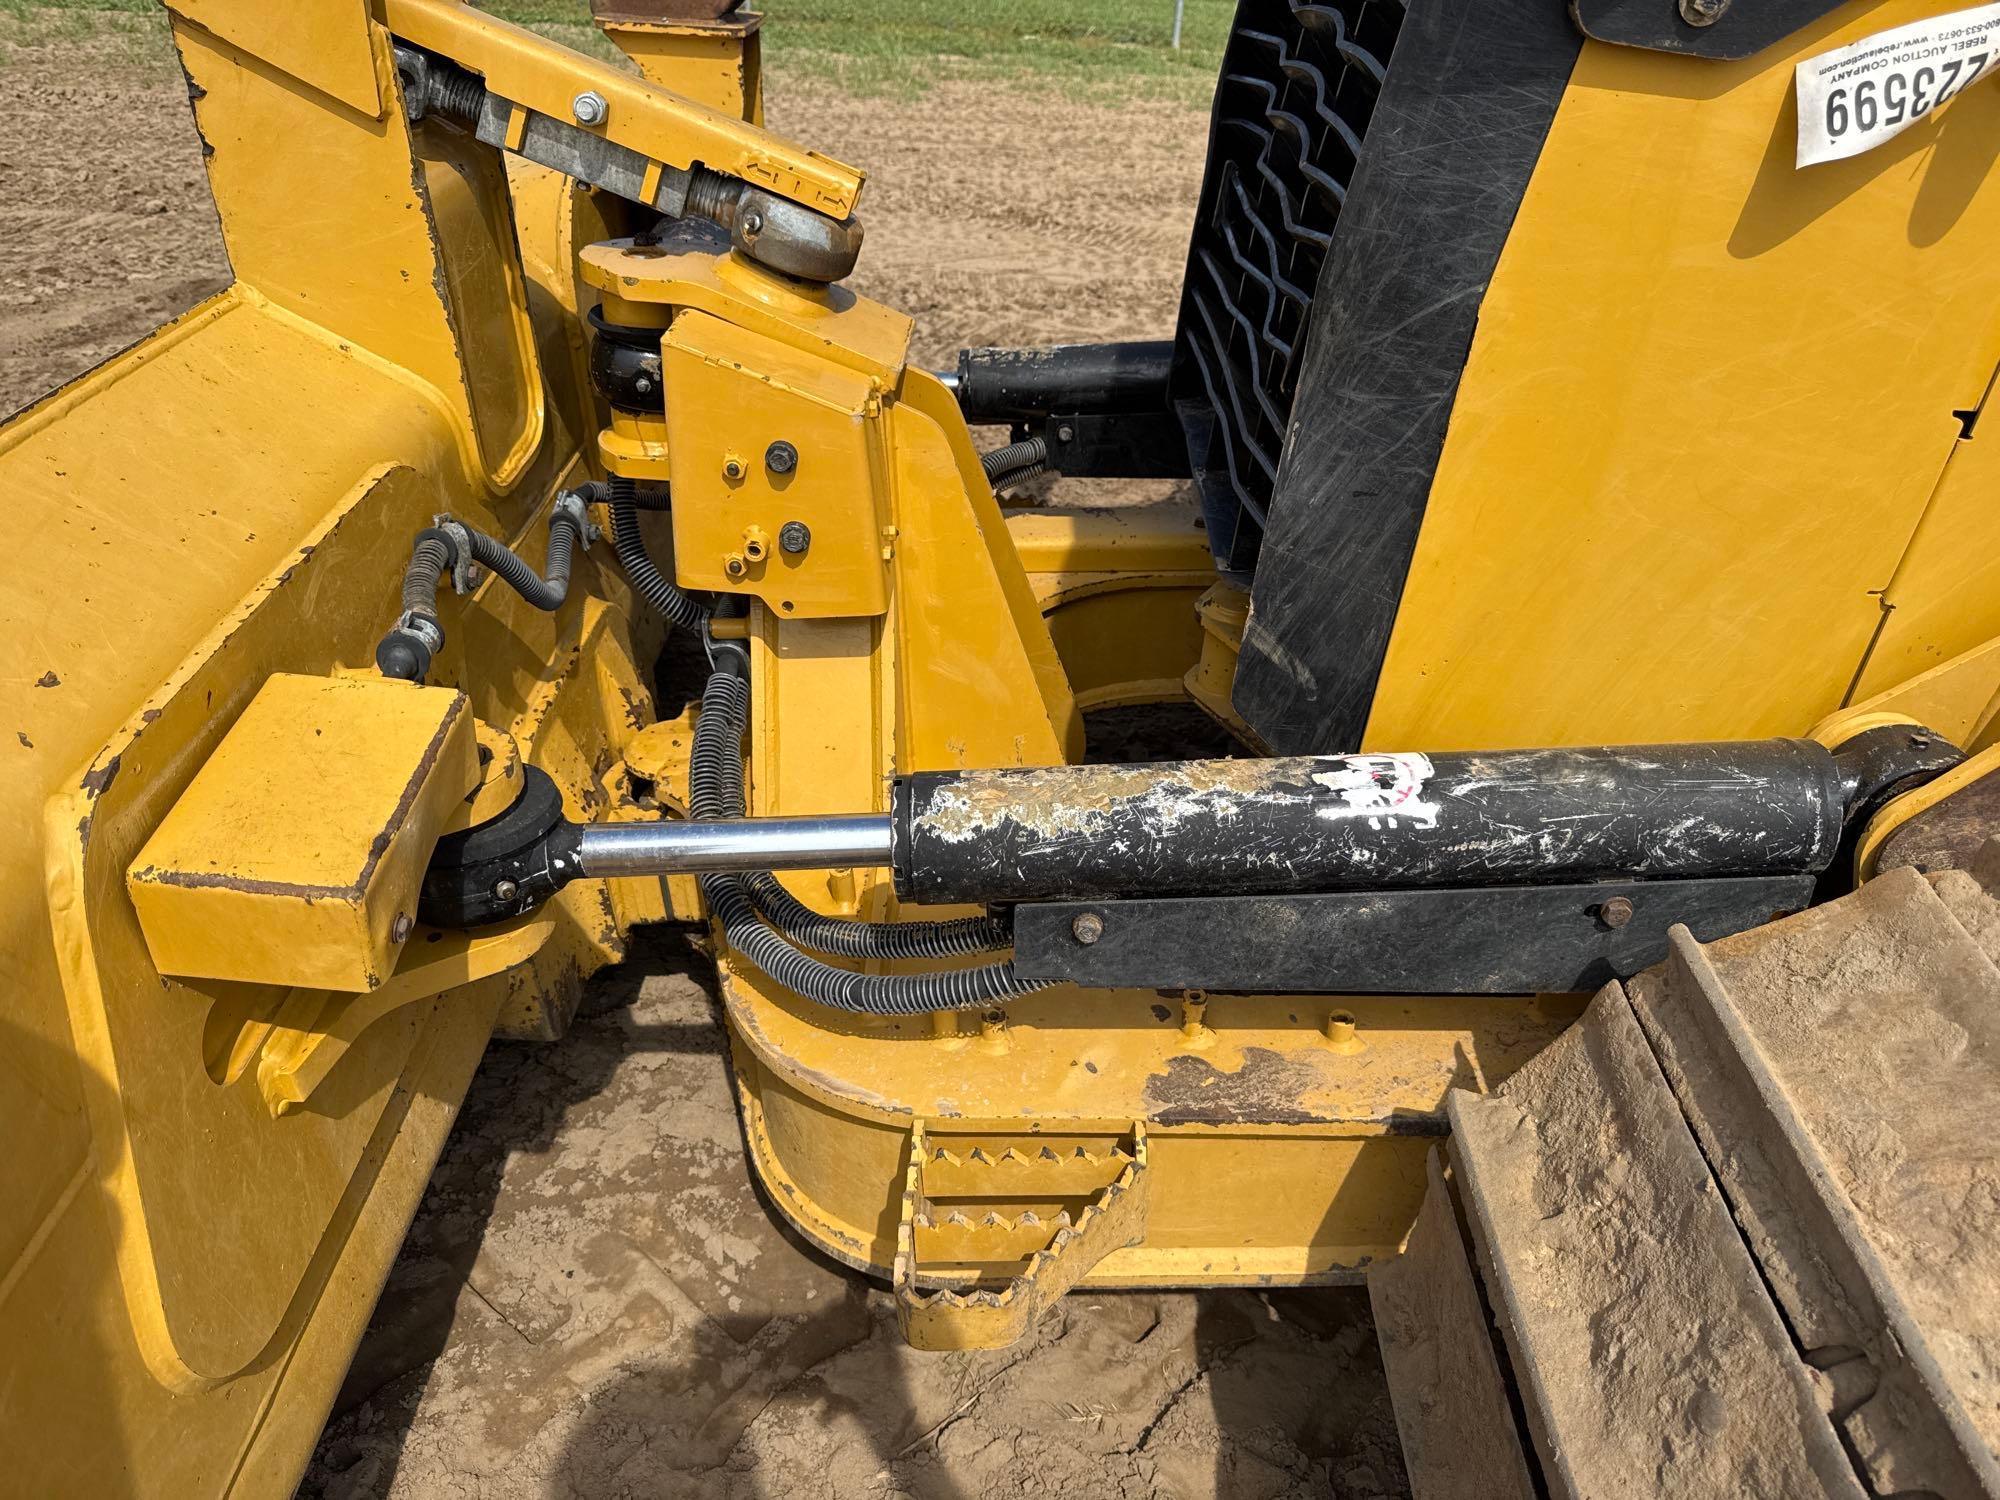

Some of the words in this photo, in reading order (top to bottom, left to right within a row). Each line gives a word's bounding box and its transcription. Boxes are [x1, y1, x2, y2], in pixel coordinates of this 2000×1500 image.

[1892, 44, 1947, 64] AUCTION
[1951, 35, 1988, 52] REBEL
[1818, 35, 1928, 76] www.rebelauction.com
[1830, 57, 1888, 84] COMPANY
